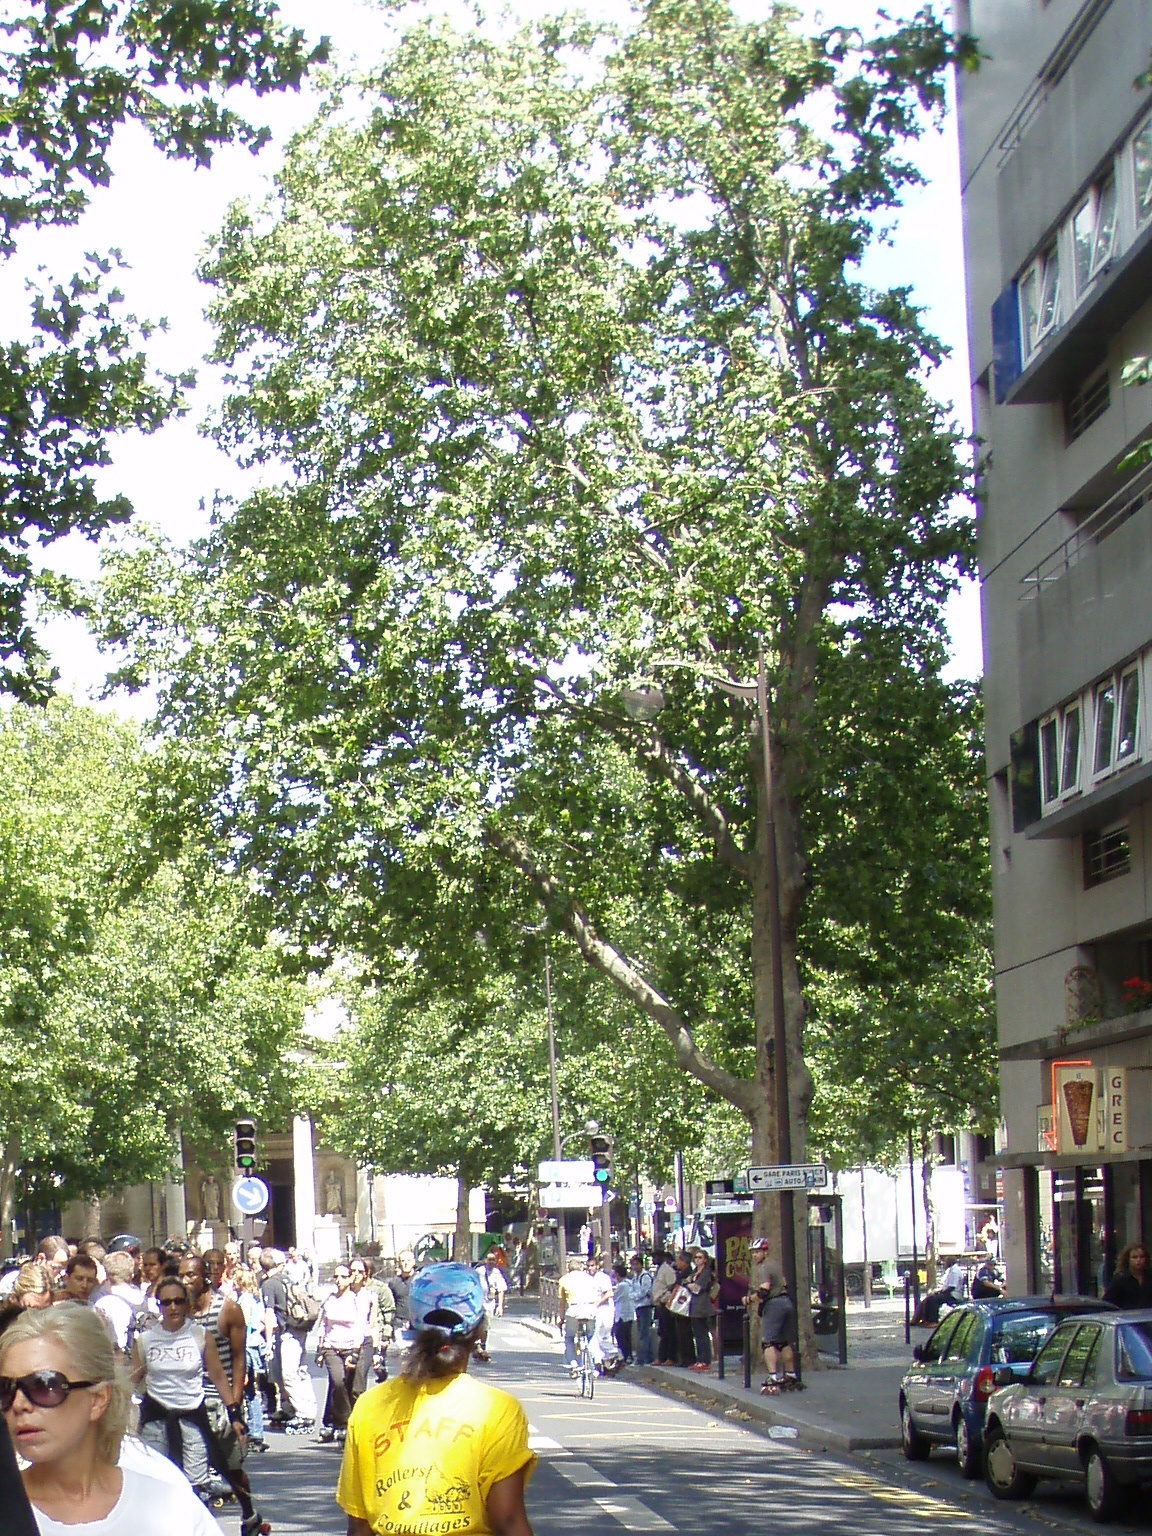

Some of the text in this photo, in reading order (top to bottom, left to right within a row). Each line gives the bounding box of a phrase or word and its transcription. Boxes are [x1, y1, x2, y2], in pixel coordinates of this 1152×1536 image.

[1110, 1075, 1124, 1144] GREC
[374, 1417, 475, 1458] STAFF
[375, 1464, 427, 1498] Rollers
[397, 1490, 412, 1511] &
[377, 1513, 471, 1535] Coquillages
